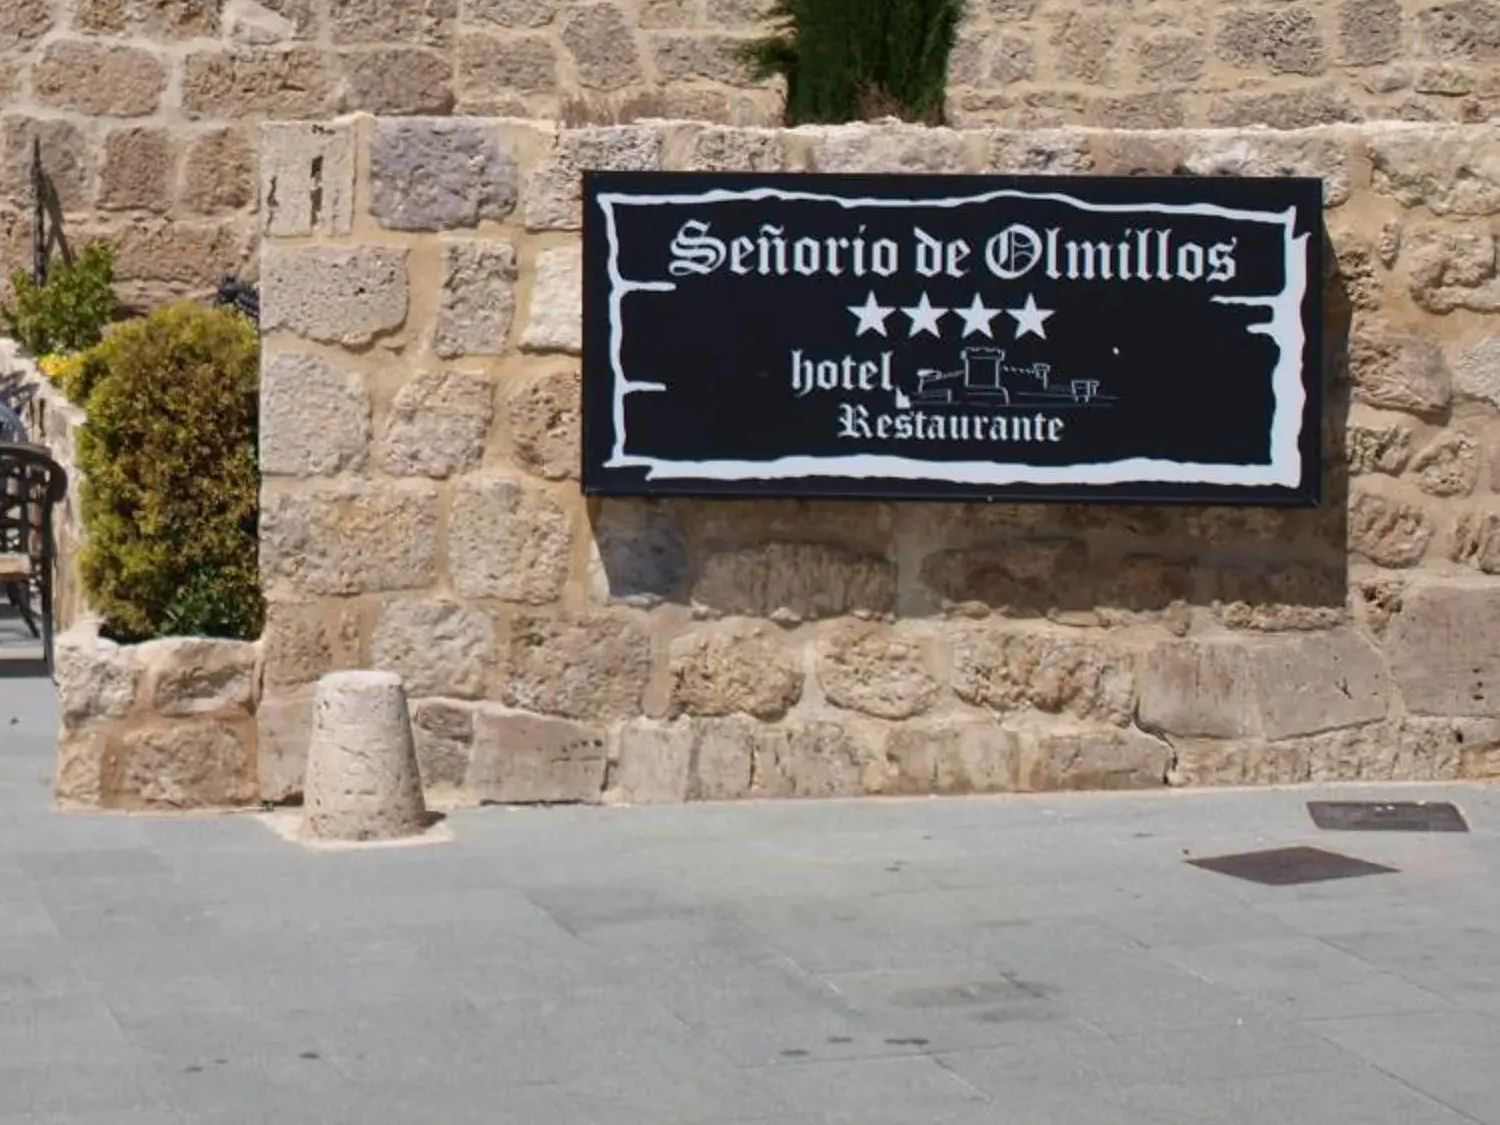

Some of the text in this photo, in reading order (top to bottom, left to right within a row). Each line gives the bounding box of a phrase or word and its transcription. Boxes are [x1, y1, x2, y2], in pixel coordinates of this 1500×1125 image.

[913, 225, 971, 277] de
[985, 224, 1238, 282] Olmillos
[791, 349, 895, 396] hotel
[836, 403, 1065, 442] Restaurante
